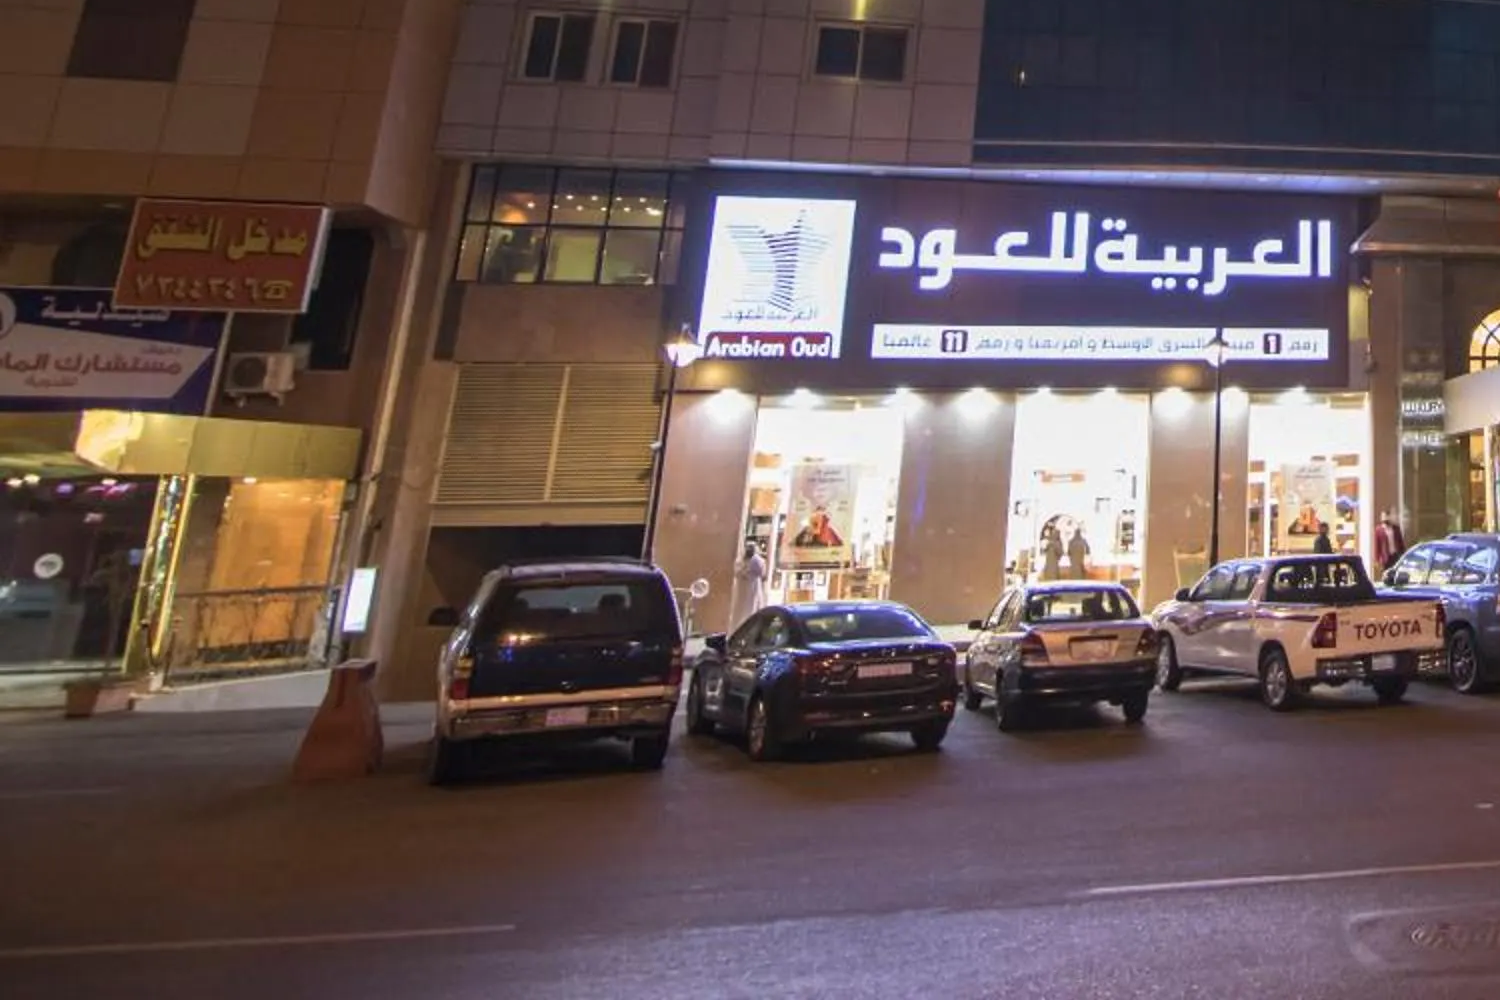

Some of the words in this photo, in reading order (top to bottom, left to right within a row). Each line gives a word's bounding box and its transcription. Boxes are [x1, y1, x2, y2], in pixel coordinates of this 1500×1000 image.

[136, 213, 224, 260] الشقق
[226, 216, 308, 260] مدخل
[878, 211, 1089, 290] للعود
[1094, 218, 1331, 296] العربية
[706, 334, 785, 358] Arabian
[790, 334, 831, 358] Oud
[943, 331, 967, 352] 11
[1354, 619, 1422, 641] TOYOTA
